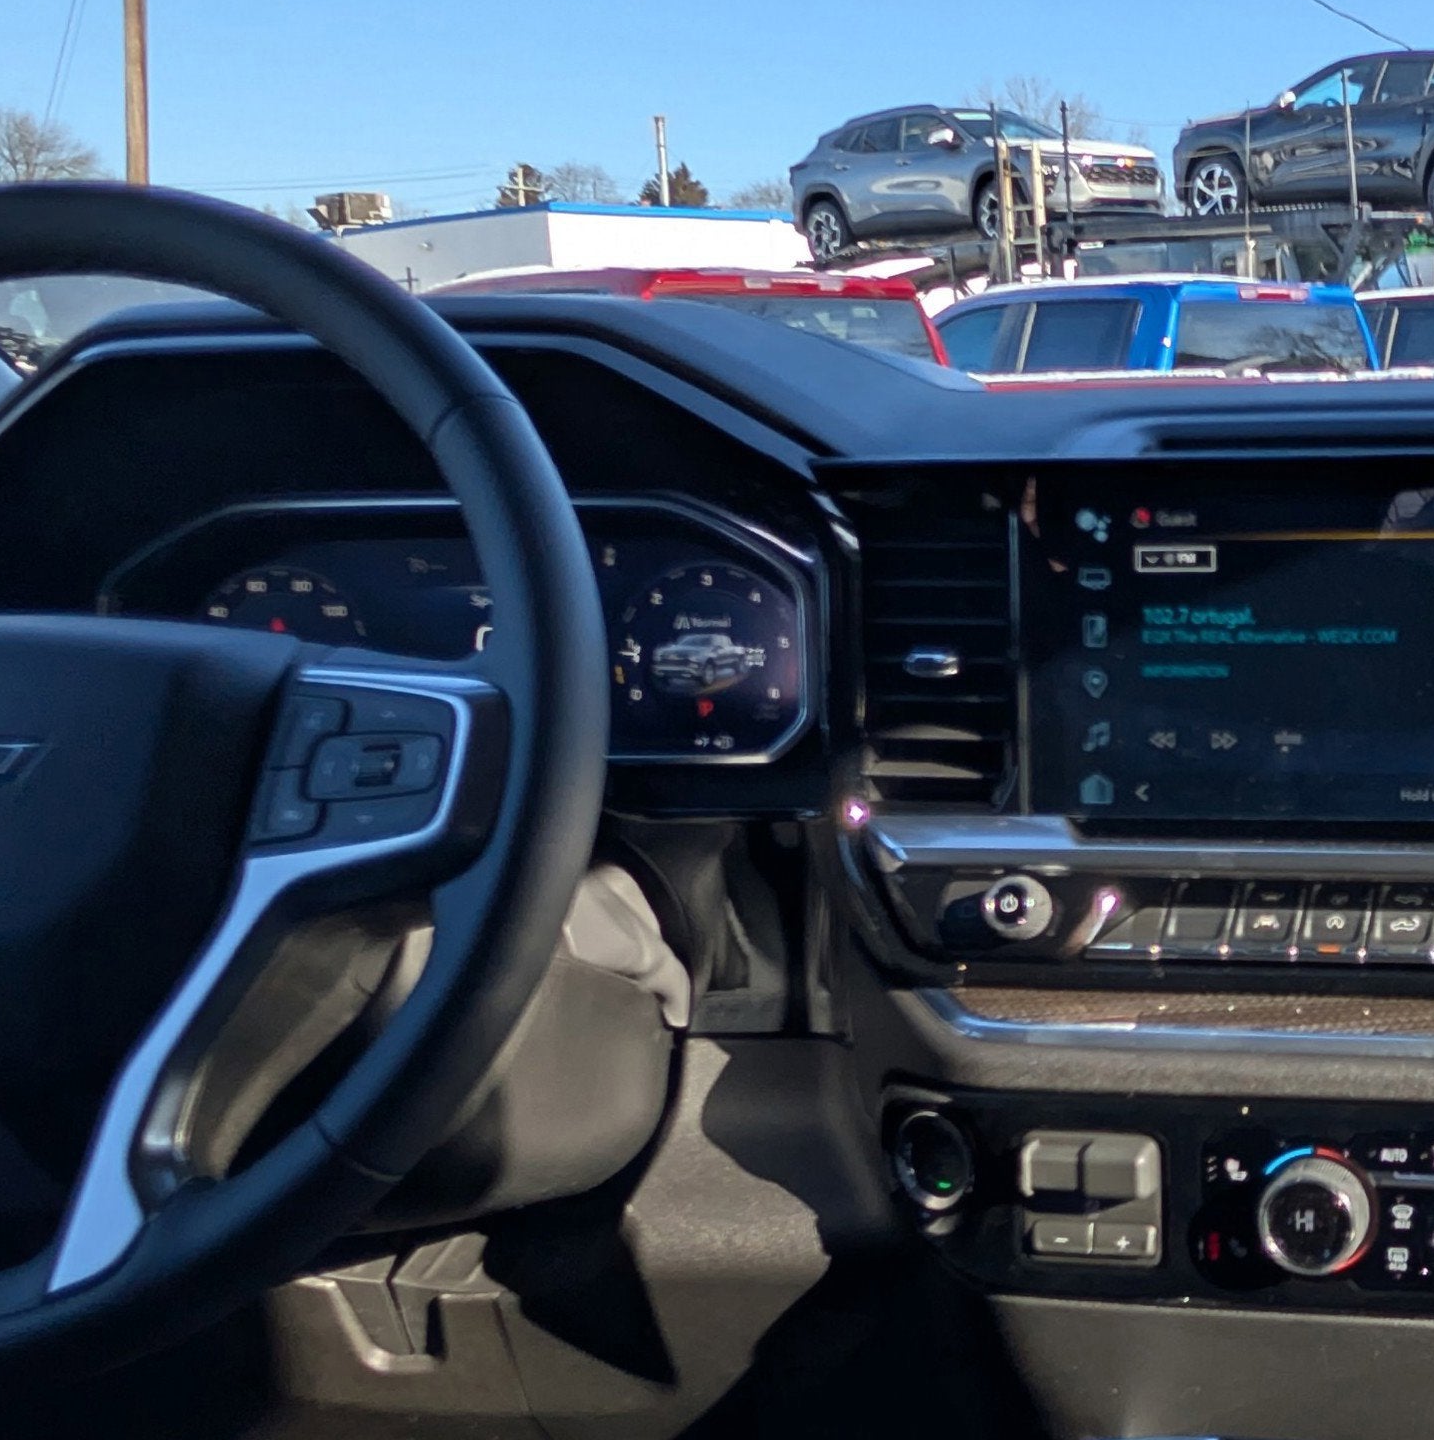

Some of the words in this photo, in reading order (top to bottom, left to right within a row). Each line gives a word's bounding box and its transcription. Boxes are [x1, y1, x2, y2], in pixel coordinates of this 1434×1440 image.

[1400, 788, 1429, 803] Hold
[1380, 1148, 1408, 1163] AUTO
[1294, 1209, 1315, 1233] HI
